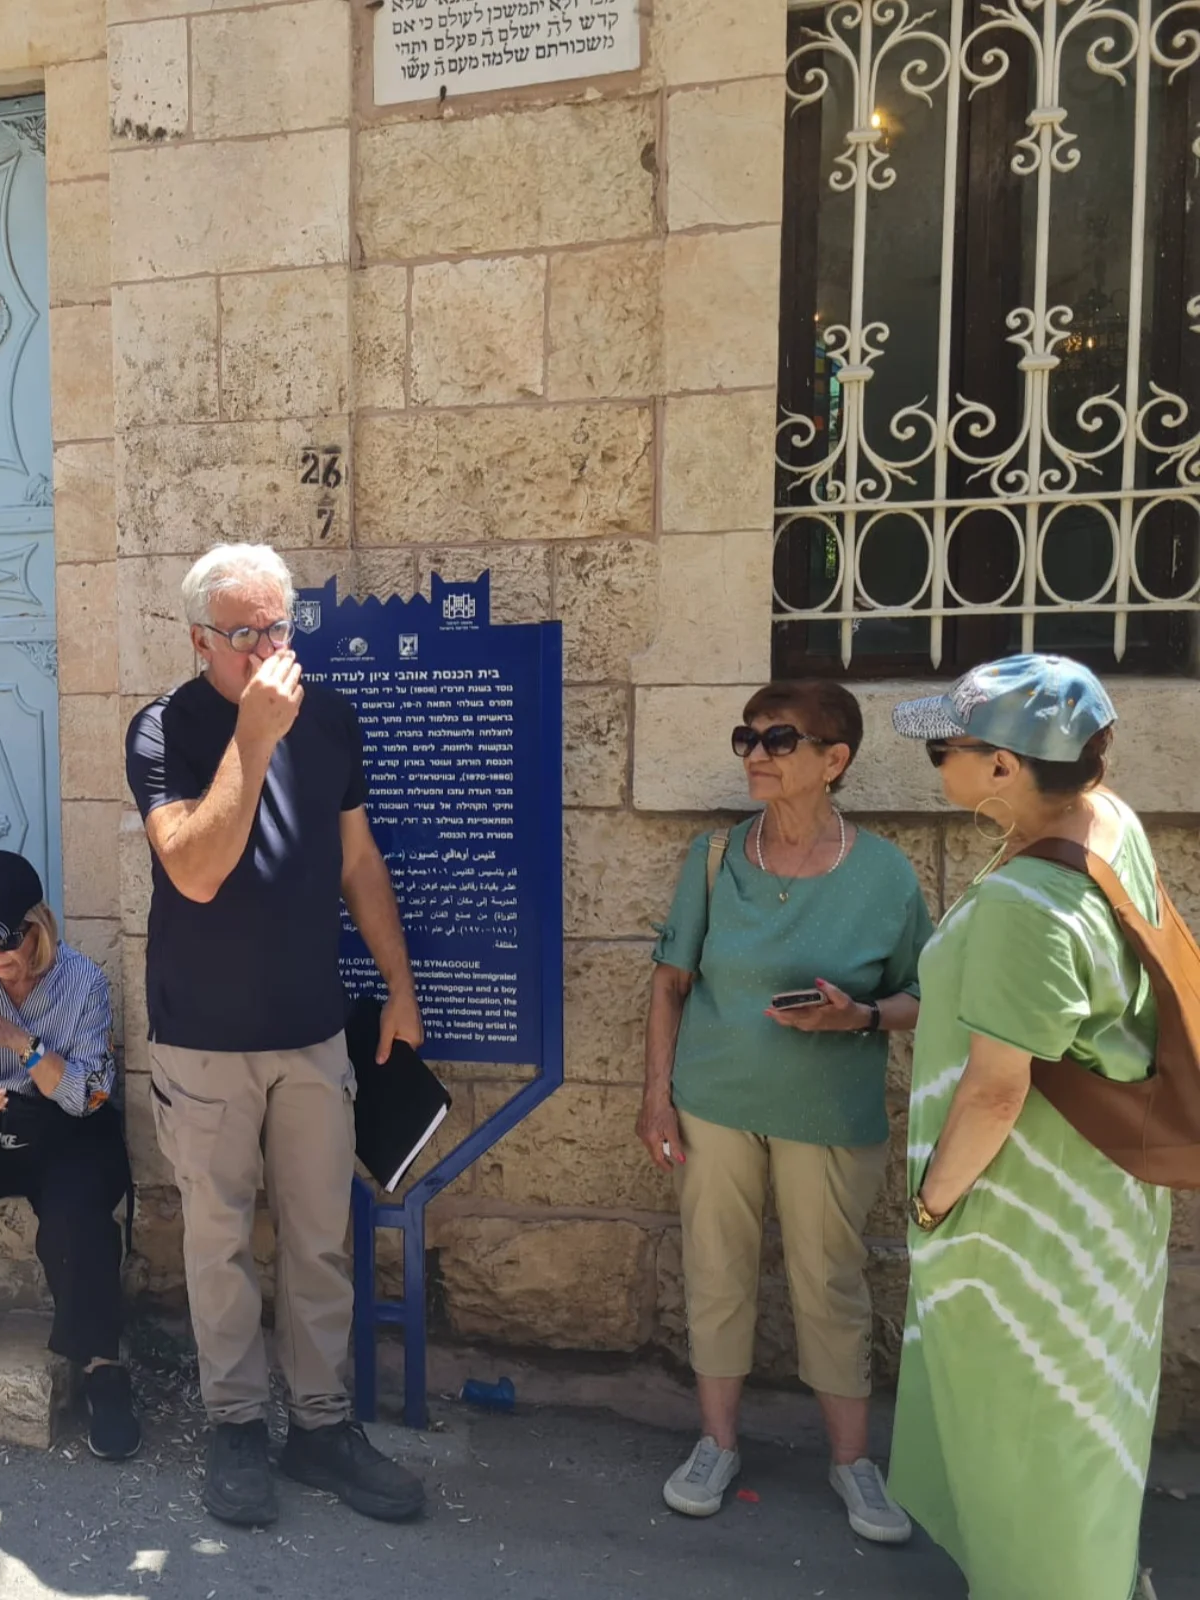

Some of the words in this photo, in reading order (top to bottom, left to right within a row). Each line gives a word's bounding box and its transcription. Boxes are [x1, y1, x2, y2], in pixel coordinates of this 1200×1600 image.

[392, 20, 416, 35] אם
[331, 671, 365, 683] לעדת
[369, 671, 391, 684] ציון
[395, 670, 429, 682] אוהבי
[432, 670, 474, 681] הכנסת
[477, 669, 500, 680] בית
[397, 686, 407, 694] על
[468, 685, 492, 693] בשנת
[485, 758, 513, 766] הכנסת
[469, 831, 484, 840] בית
[471, 850, 496, 862] كنيس
[423, 960, 481, 970] SYNAGOGUE
[414, 970, 453, 979] ssociation
[454, 971, 472, 980] who
[429, 984, 474, 994] synagogue
[475, 984, 492, 993] and
[501, 985, 518, 996] boy
[425, 995, 433, 1003] to
[435, 995, 466, 1004] another
[504, 997, 518, 1006] the
[446, 1007, 483, 1017] windows
[485, 1008, 501, 1017] and
[503, 1009, 518, 1018] the
[444, 1031, 473, 1041] shared
[474, 1032, 486, 1043] by
[487, 1034, 518, 1043] several
